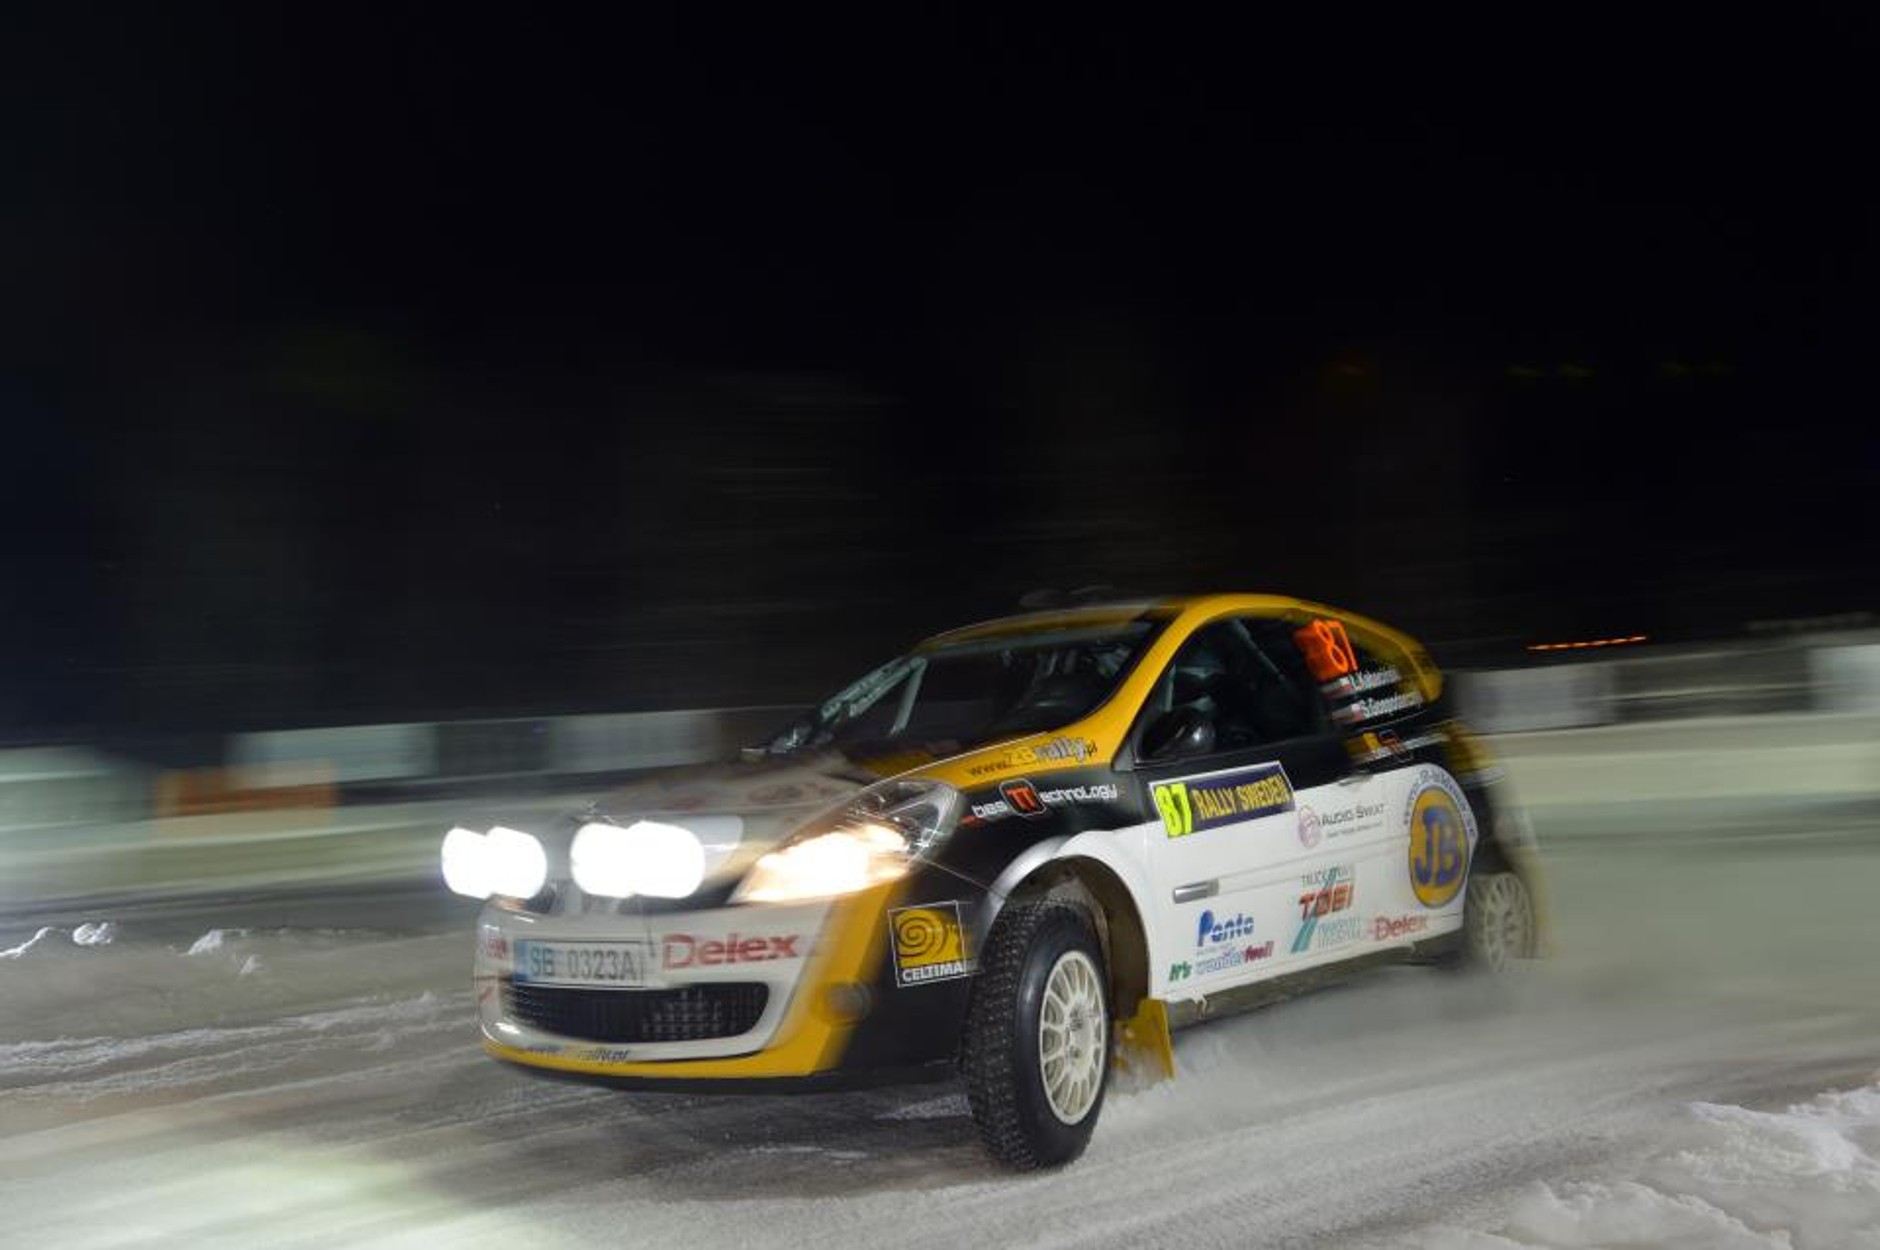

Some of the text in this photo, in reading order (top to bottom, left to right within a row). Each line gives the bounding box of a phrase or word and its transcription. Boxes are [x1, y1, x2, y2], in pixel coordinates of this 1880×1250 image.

[1312, 619, 1358, 673] 87
[1155, 773, 1290, 837] 87 RALLY SWEDEN
[1414, 805, 1462, 887] JB
[1374, 913, 1428, 941] Delex
[661, 933, 800, 972] Delex
[902, 960, 964, 982] CELTIMA
